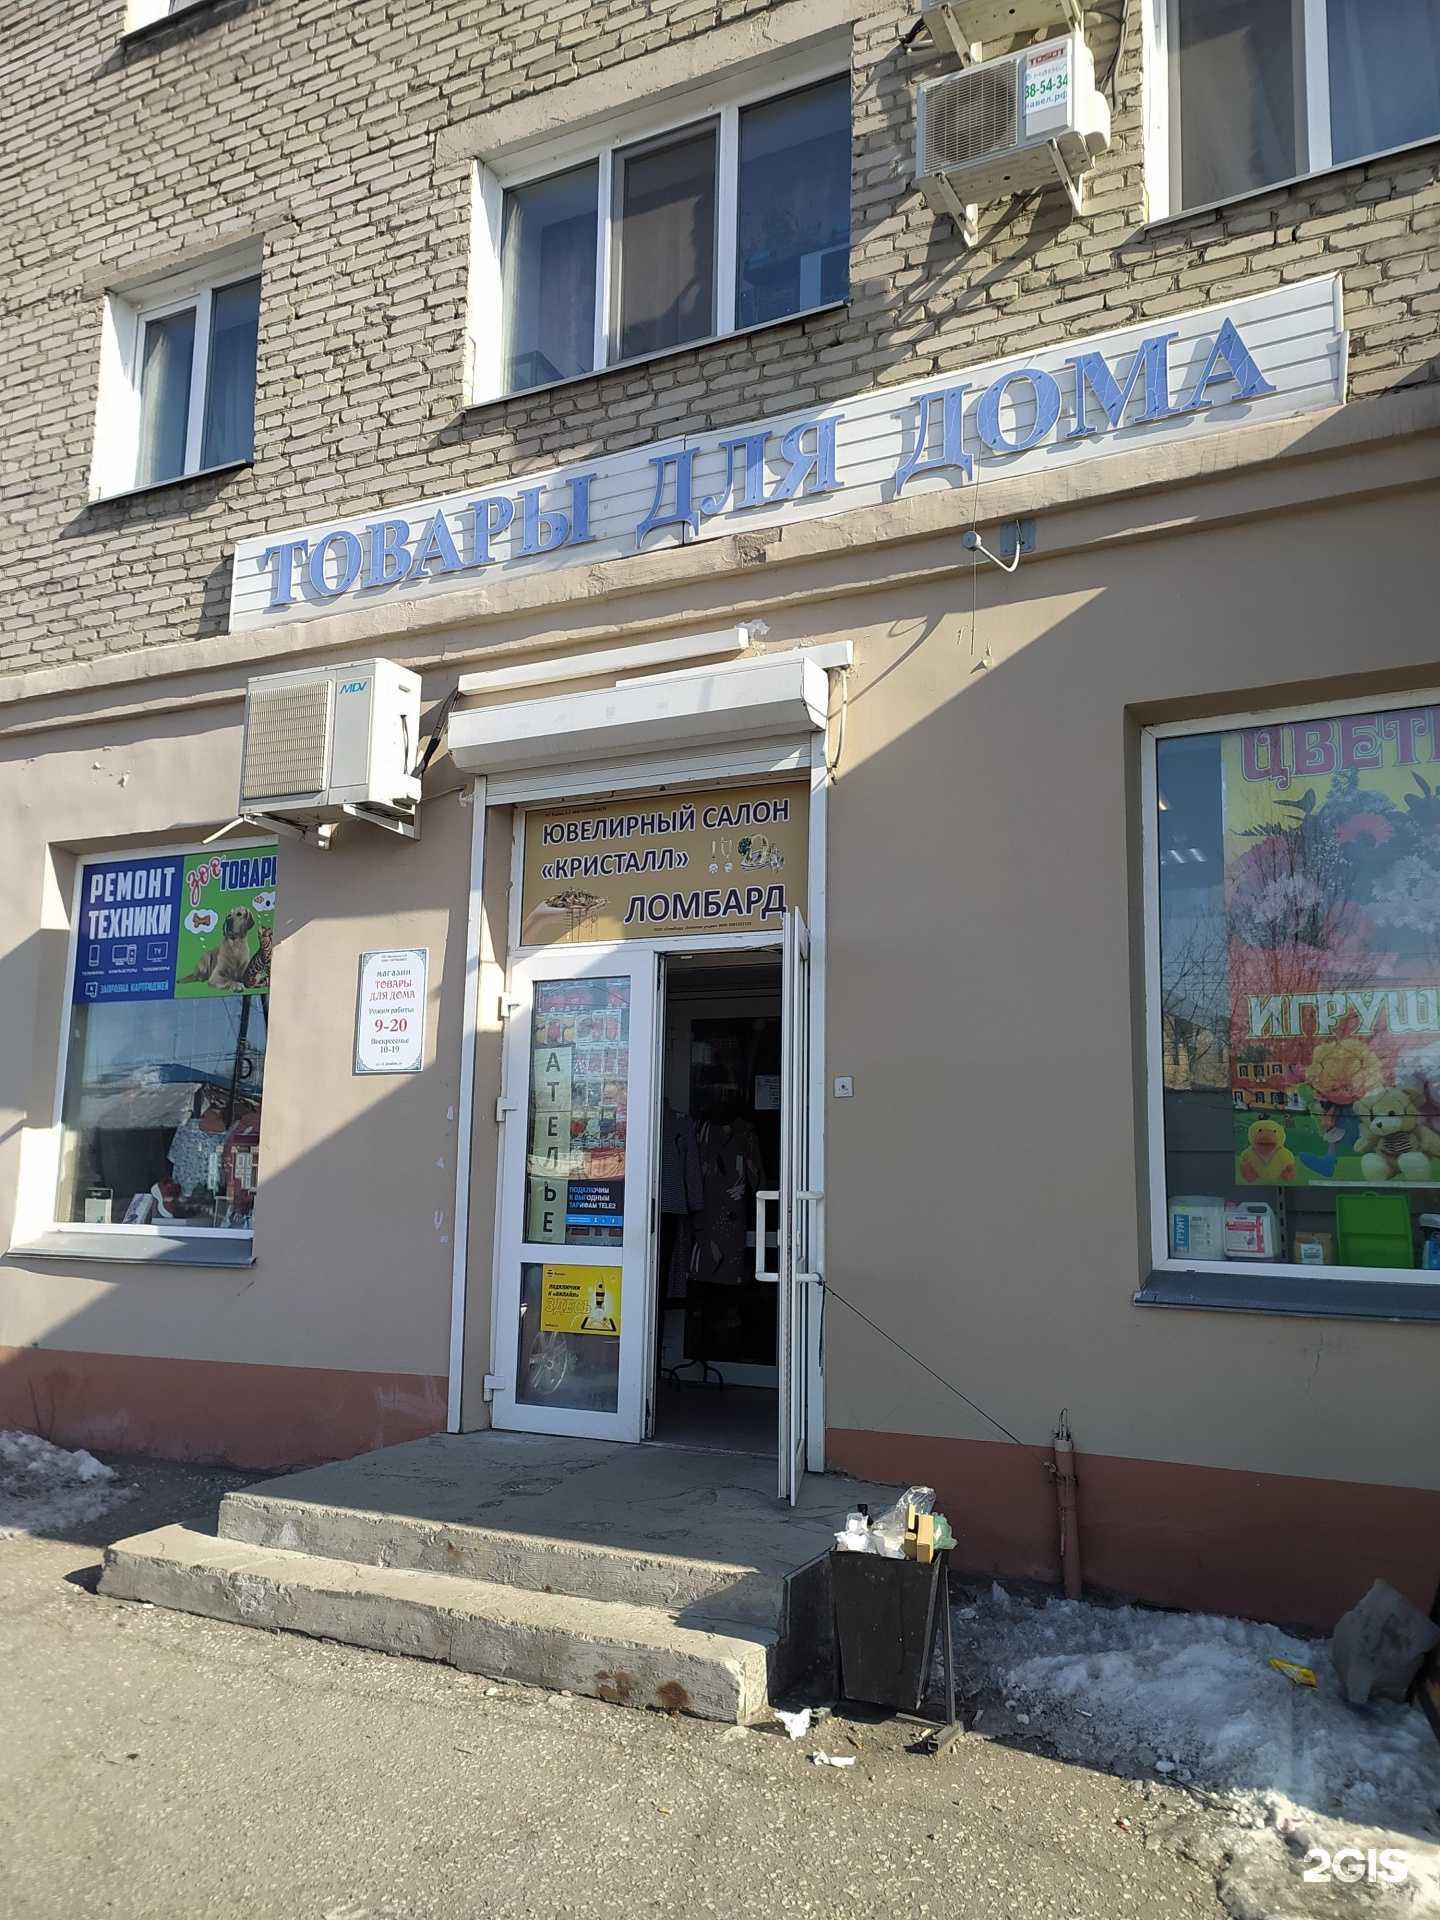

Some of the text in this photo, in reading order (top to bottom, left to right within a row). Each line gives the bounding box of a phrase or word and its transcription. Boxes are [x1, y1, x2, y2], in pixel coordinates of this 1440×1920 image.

[263, 317, 1276, 606] ТОВАРЫ ДЛЯ ДОМА
[340, 681, 368, 695] MDV
[543, 799, 789, 845] ЮВЕЛИРНЫЙ САЛОН
[541, 849, 689, 880] «КРИСТАЛЛ»
[89, 867, 175, 904] РЕМОНТ
[624, 884, 787, 925] ЛОМБАРД
[88, 904, 172, 940] ТЕХНИКИ
[375, 979, 412, 989] ТОВАРЫ
[377, 969, 411, 978] магазин
[369, 990, 416, 1002] ДЛЯ ДОМА
[374, 1018, 408, 1032] 9-20
[380, 1045, 400, 1054] 10-19
[543, 1052, 560, 1233] АТЕЛЬЕ
